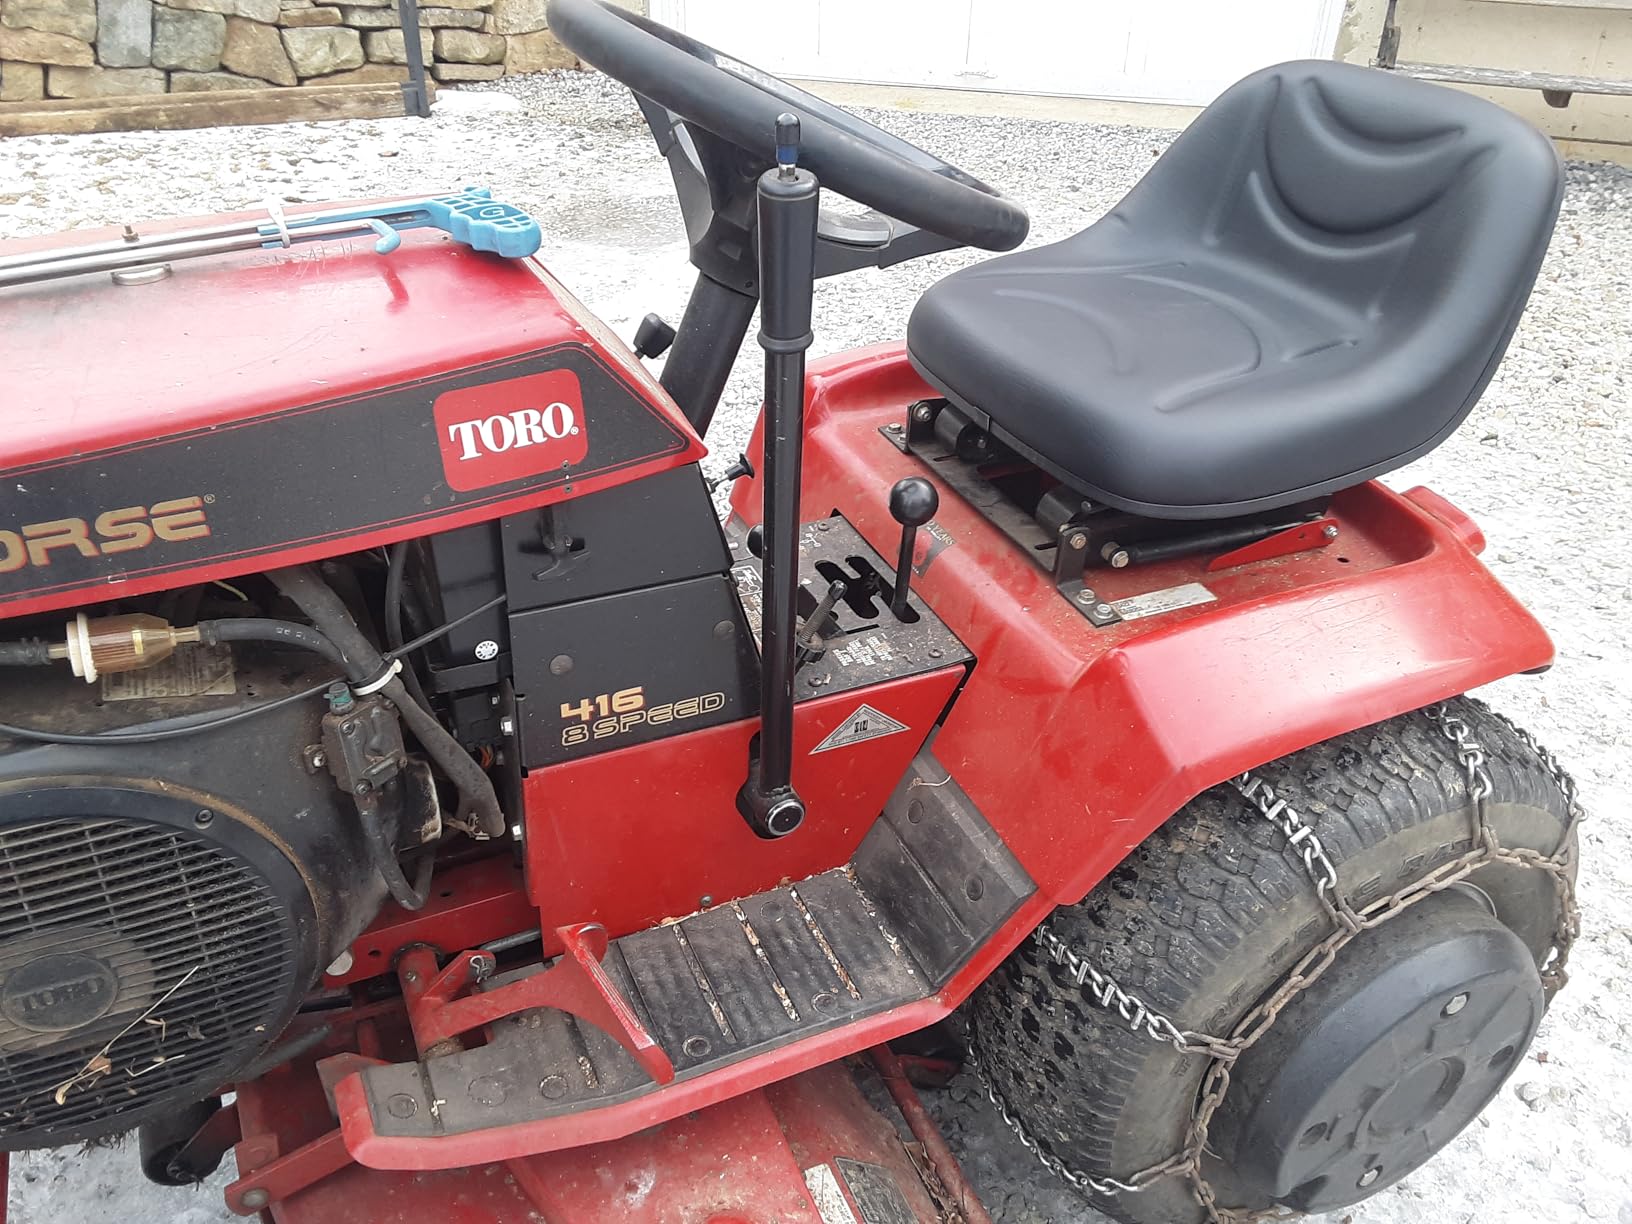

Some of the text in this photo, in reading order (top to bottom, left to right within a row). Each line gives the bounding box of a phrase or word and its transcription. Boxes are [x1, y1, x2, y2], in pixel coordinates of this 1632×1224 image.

[448, 402, 575, 461] TORO
[560, 686, 644, 721] 416
[562, 692, 725, 746] 8 SPEED
